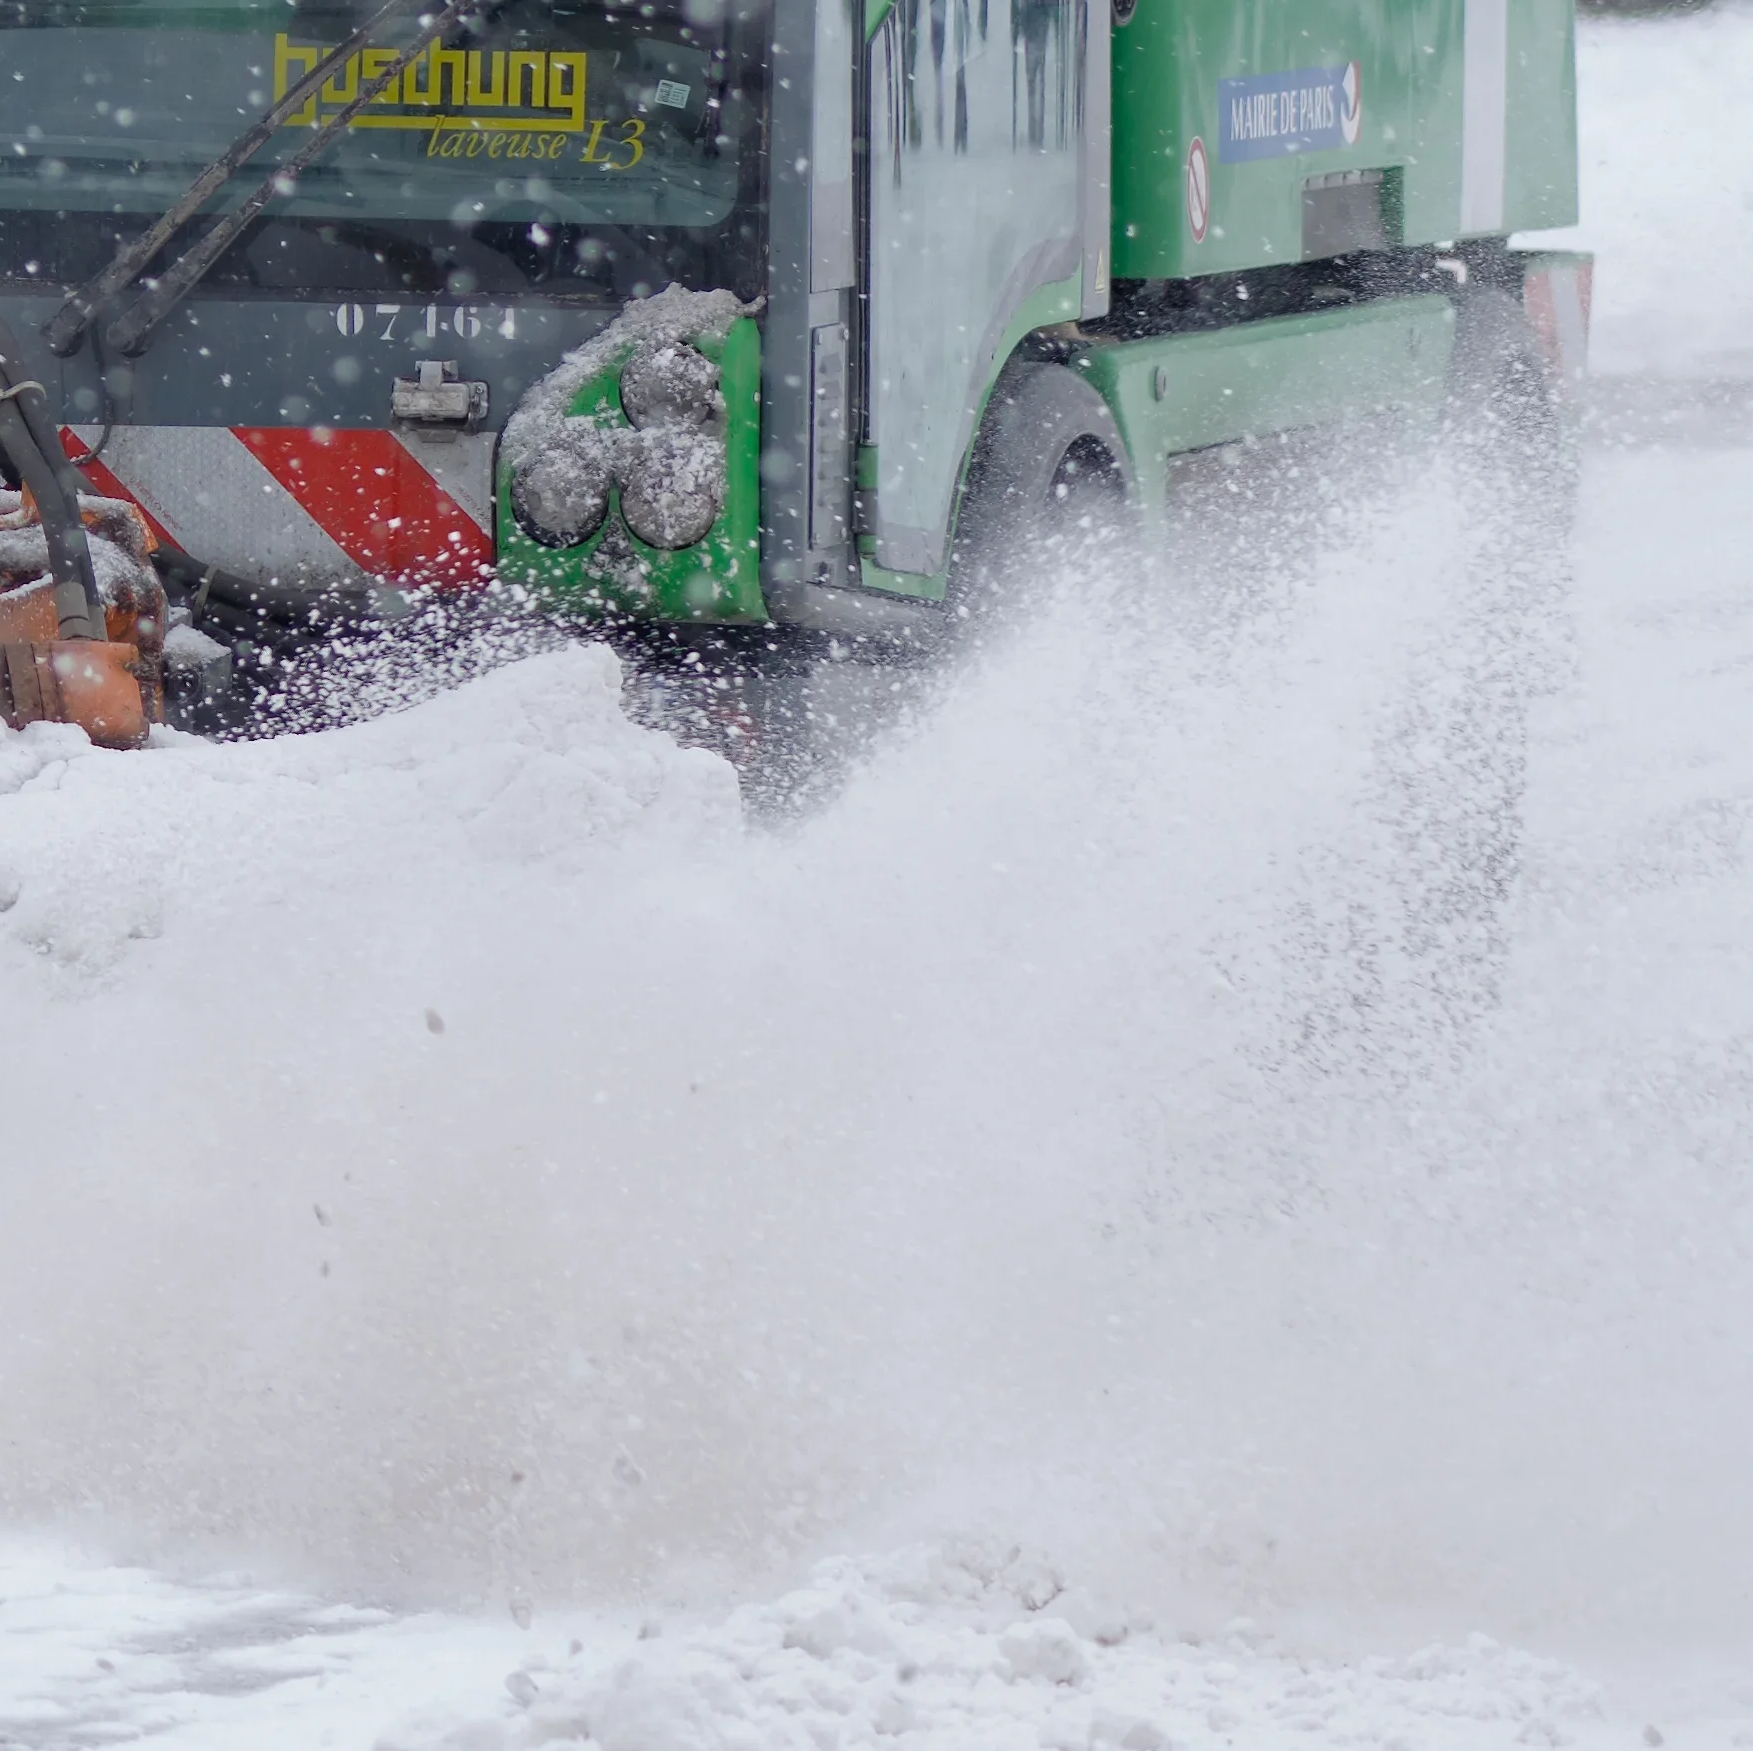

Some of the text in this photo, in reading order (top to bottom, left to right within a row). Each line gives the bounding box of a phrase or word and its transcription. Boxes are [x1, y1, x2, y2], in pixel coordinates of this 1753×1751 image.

[273, 32, 587, 133] boschung
[426, 114, 647, 170] laveuse L3
[1230, 84, 1335, 142] MAIRIE DE PARIS
